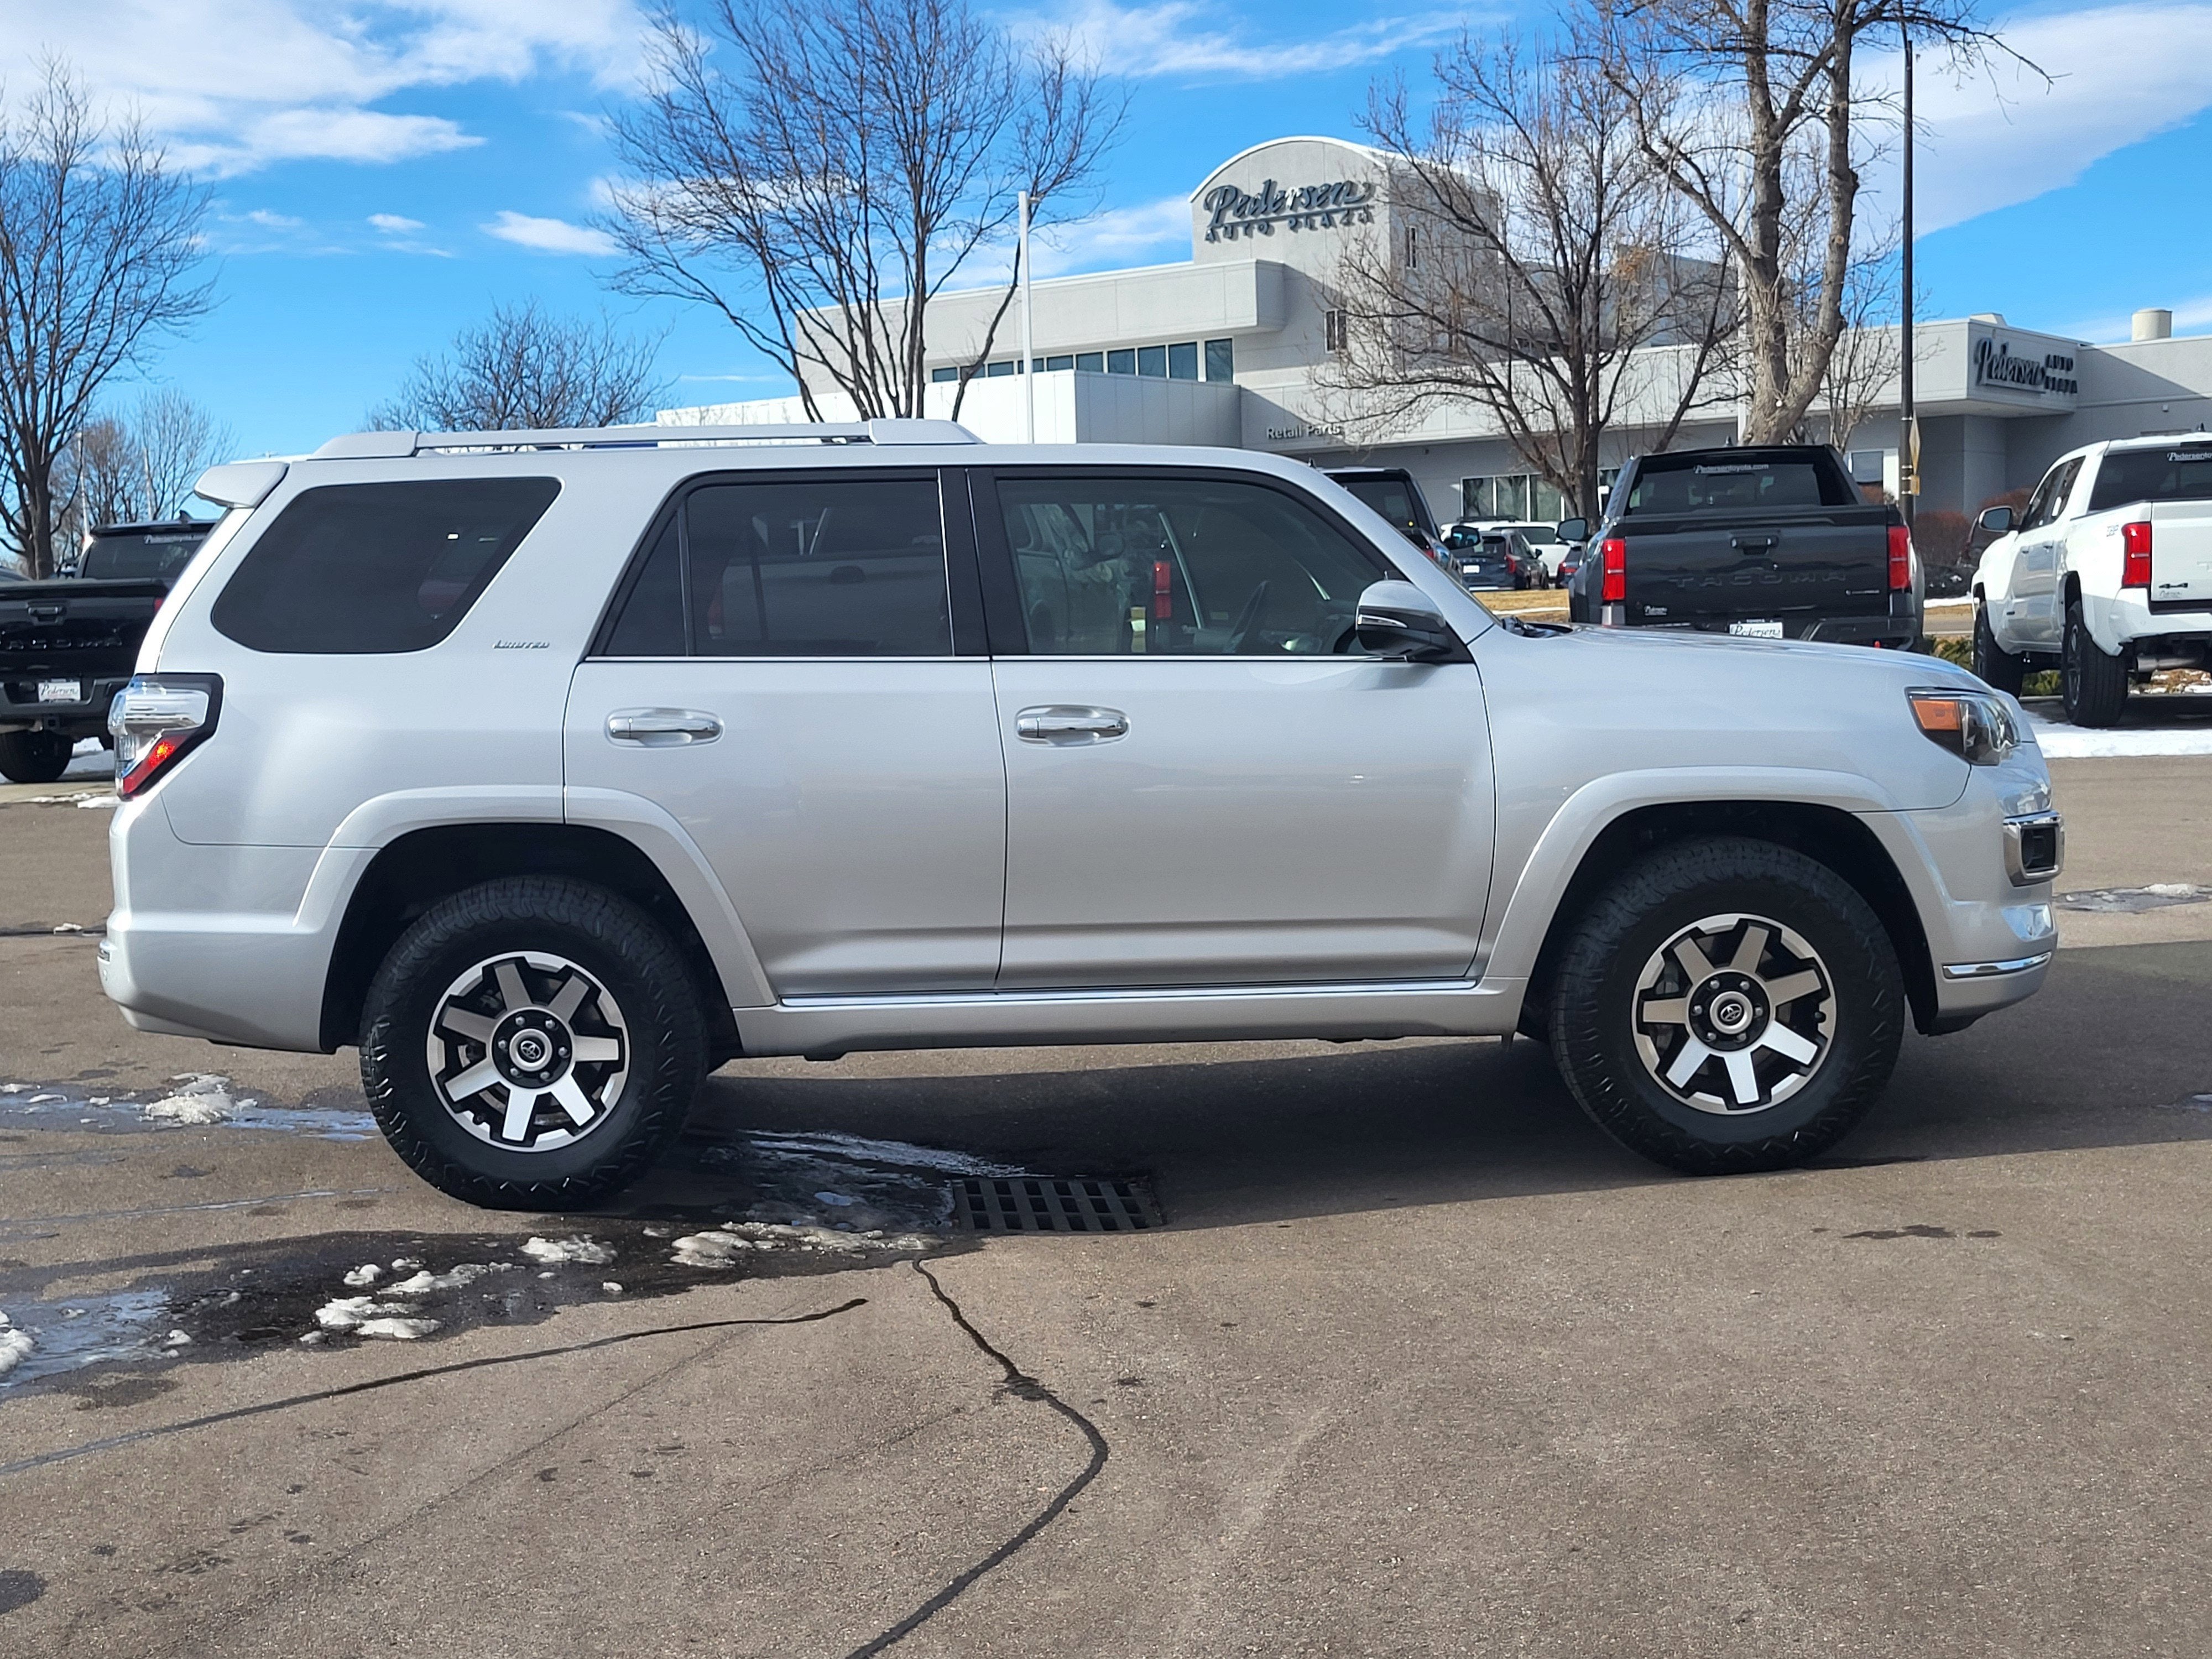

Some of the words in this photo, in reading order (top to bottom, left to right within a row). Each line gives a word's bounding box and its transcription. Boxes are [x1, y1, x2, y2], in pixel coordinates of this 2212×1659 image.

[1203, 178, 1375, 227] Pedersen
[1204, 221, 1274, 243] AUTO
[1288, 205, 1375, 232] PLAZA
[1973, 337, 2046, 386] Pedersen
[2046, 354, 2074, 372] AUTO
[1266, 426, 1301, 440] Retail
[1307, 424, 1343, 436] Parts
[1668, 573, 1846, 588] TACOMA
